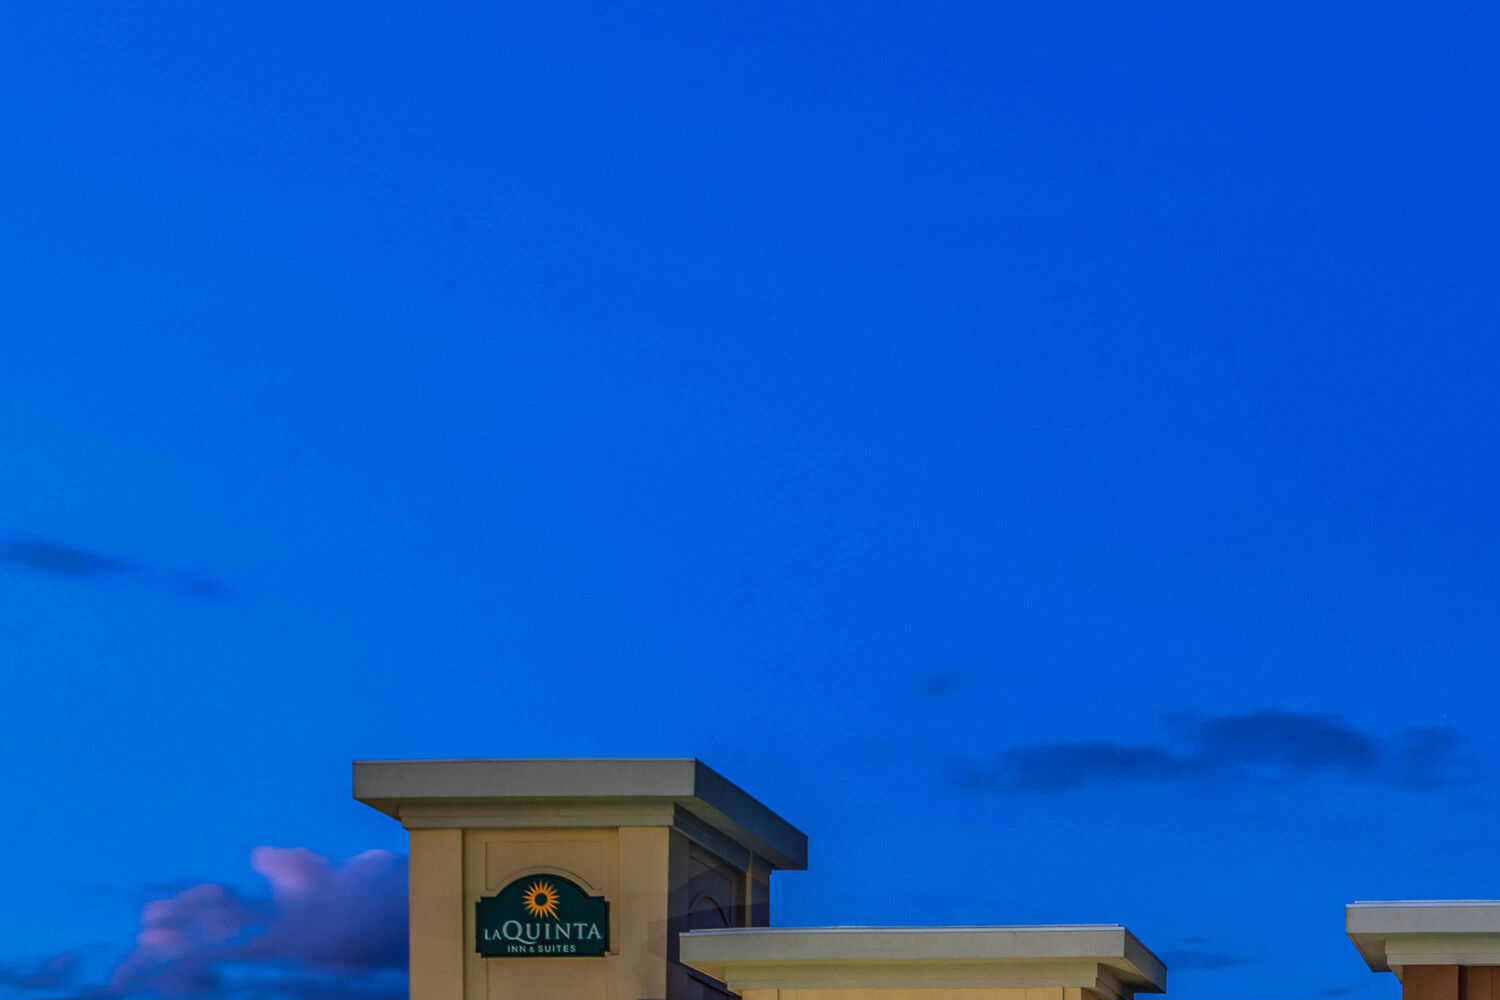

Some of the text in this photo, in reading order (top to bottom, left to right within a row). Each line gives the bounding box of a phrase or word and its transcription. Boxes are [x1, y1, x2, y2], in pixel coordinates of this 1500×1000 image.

[484, 919, 603, 945] LA QUINTA
[507, 945, 526, 953] INN
[537, 944, 577, 953] SUITES
